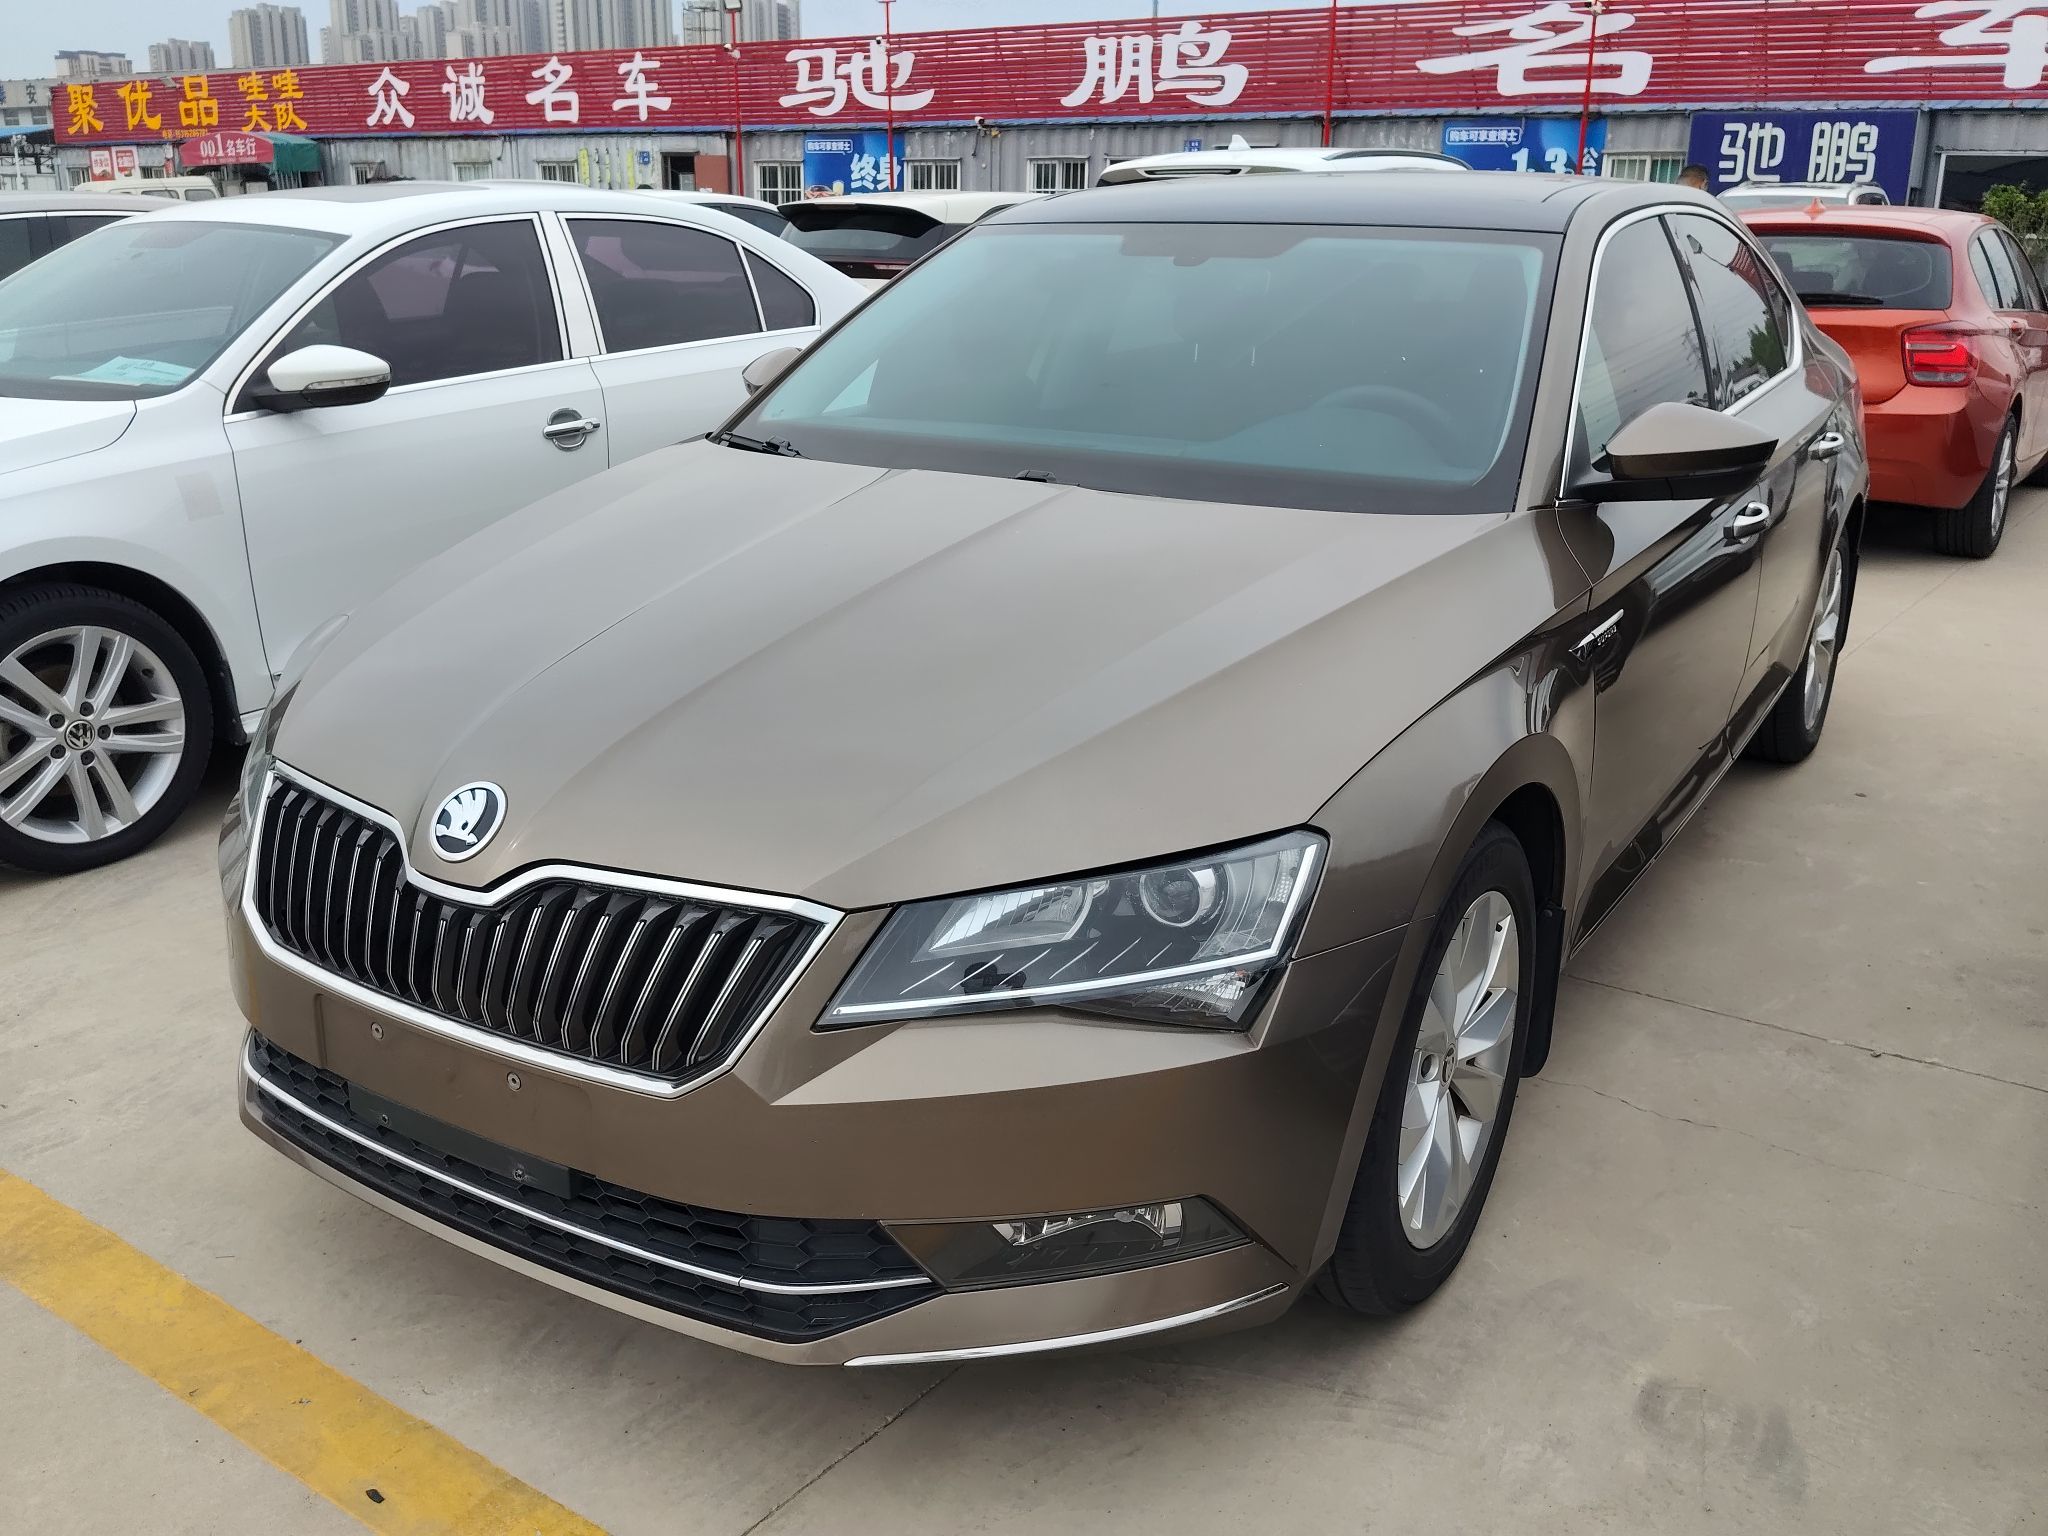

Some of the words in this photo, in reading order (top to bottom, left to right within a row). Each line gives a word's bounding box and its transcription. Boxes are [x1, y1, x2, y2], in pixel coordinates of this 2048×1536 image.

[67, 75, 219, 135] 聚优品
[237, 69, 304, 101] 哇哇
[366, 51, 672, 128] 众诚名车
[241, 101, 308, 132] 大队
[850, 153, 901, 191] 终身
[1718, 121, 1879, 183] 驰鹏
